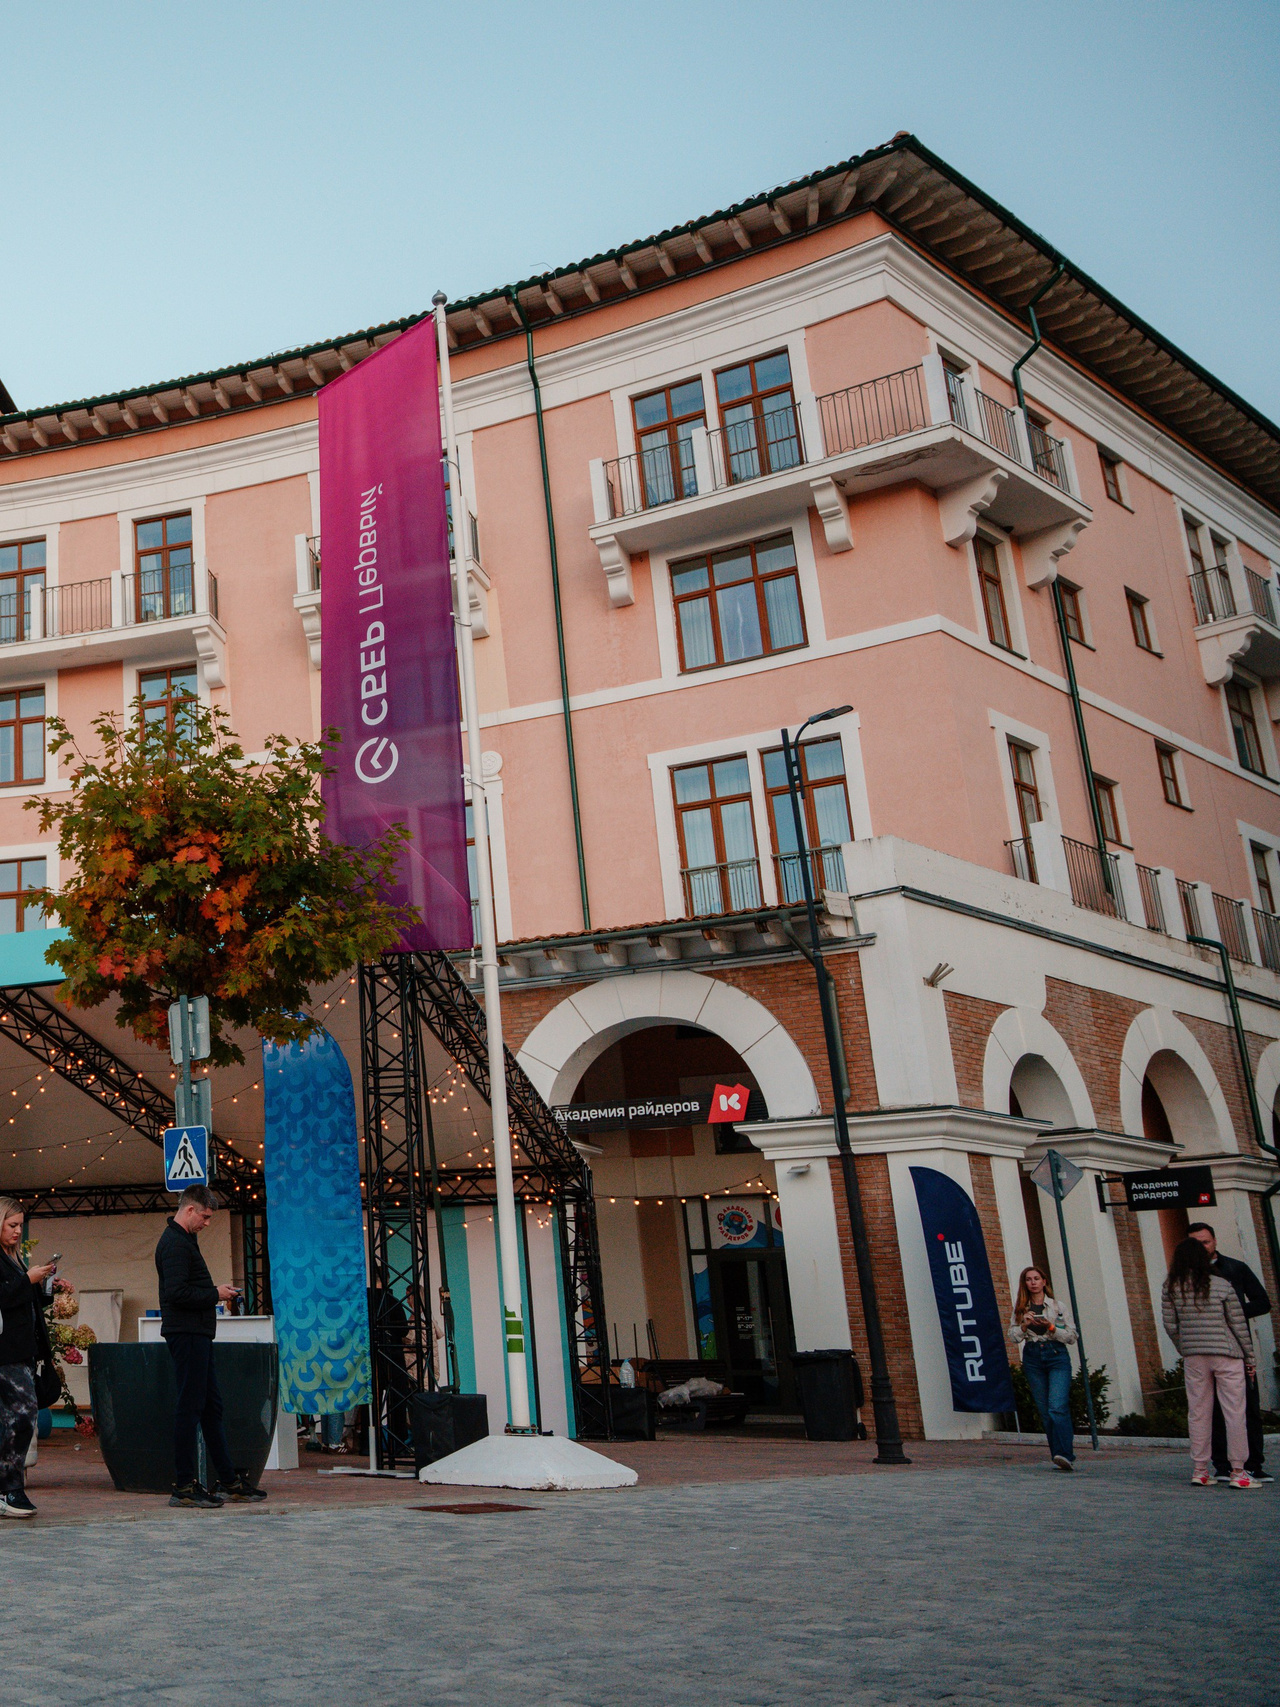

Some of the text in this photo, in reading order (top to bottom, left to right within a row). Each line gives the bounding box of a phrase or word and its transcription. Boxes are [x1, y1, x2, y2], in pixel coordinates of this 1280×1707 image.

[554, 1101, 700, 1122] Академия райдеров
[1131, 1180, 1179, 1190] Академия
[1132, 1191, 1179, 1201] райдеров
[945, 1241, 987, 1382] RUTUBE
